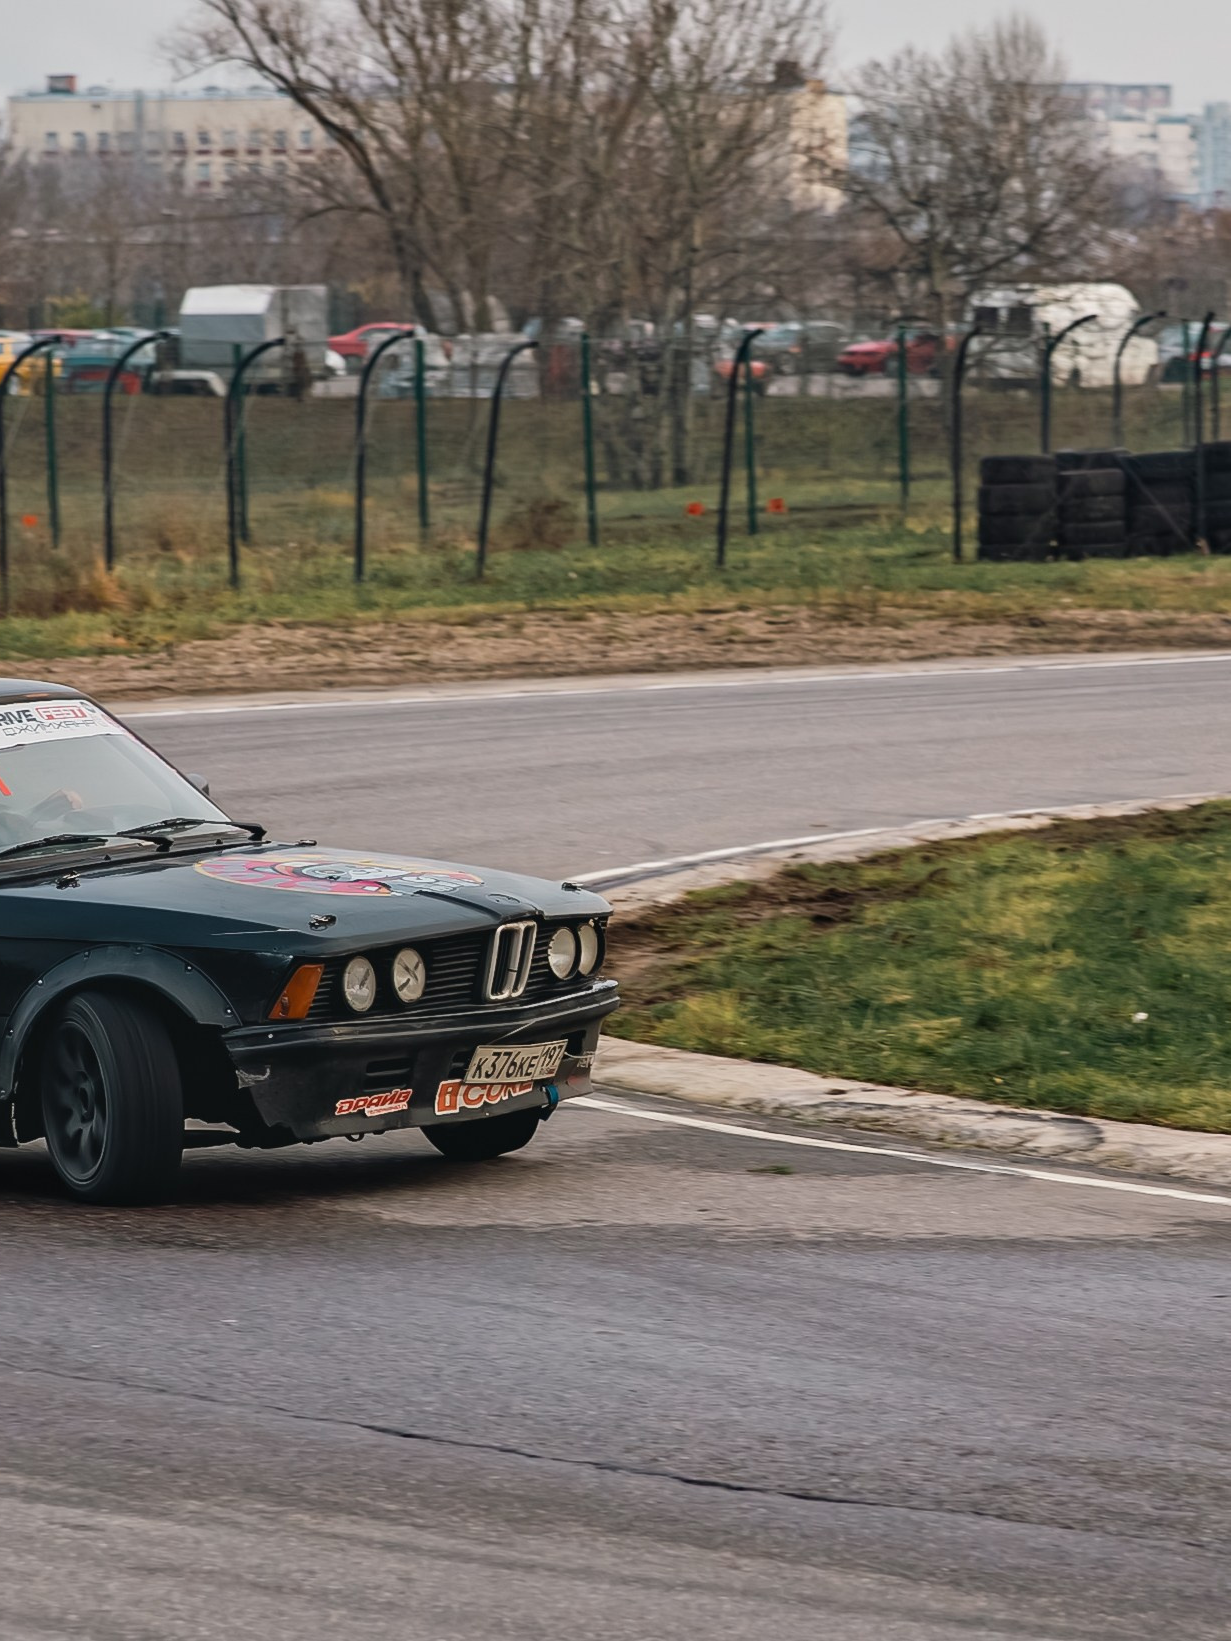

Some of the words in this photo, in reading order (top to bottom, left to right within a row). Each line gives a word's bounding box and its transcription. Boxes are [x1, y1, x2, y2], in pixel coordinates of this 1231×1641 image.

[37, 706, 88, 721] FEST
[541, 1044, 565, 1068] 197
[336, 1090, 412, 1114] ДРАЙВ
